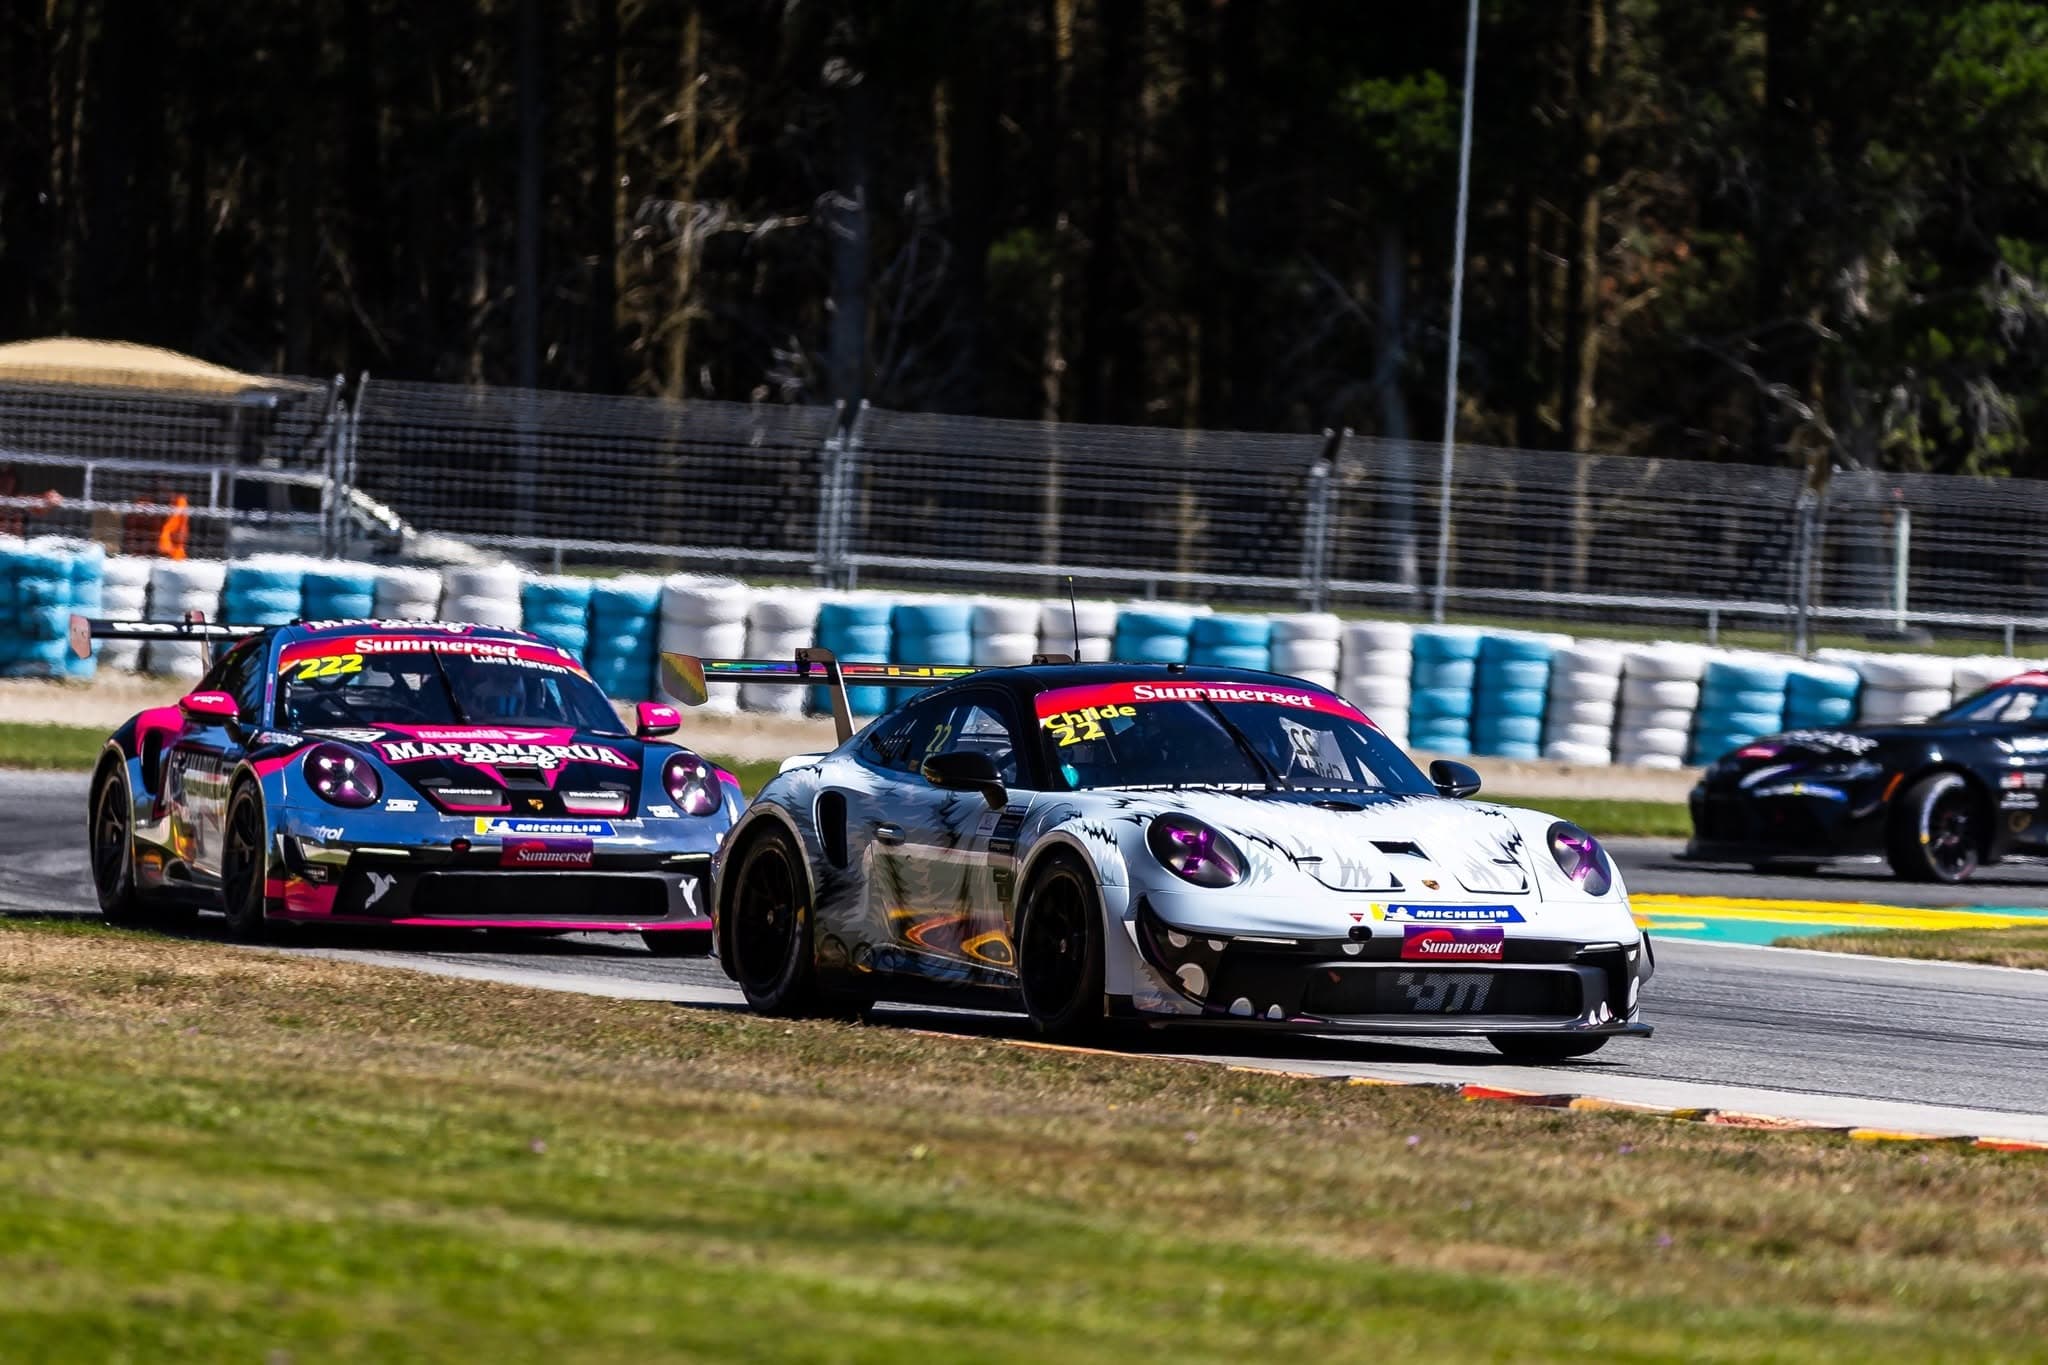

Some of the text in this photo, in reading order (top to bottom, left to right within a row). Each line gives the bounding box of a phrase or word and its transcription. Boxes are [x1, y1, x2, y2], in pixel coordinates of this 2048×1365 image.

[355, 639, 518, 658] Summerset
[297, 654, 364, 680] 222
[470, 654, 569, 675] Luke Manson
[1133, 685, 1315, 708] Summerset
[1044, 704, 1137, 729] Childe
[926, 724, 952, 753] 22
[1053, 721, 1105, 747] 22
[382, 742, 628, 767] MARAMARUA
[463, 752, 559, 769] Beef
[516, 823, 602, 833] MICHELIN
[517, 848, 593, 863] Summerset
[1415, 909, 1510, 919] MICHELIN
[1419, 938, 1503, 955] Summerset
